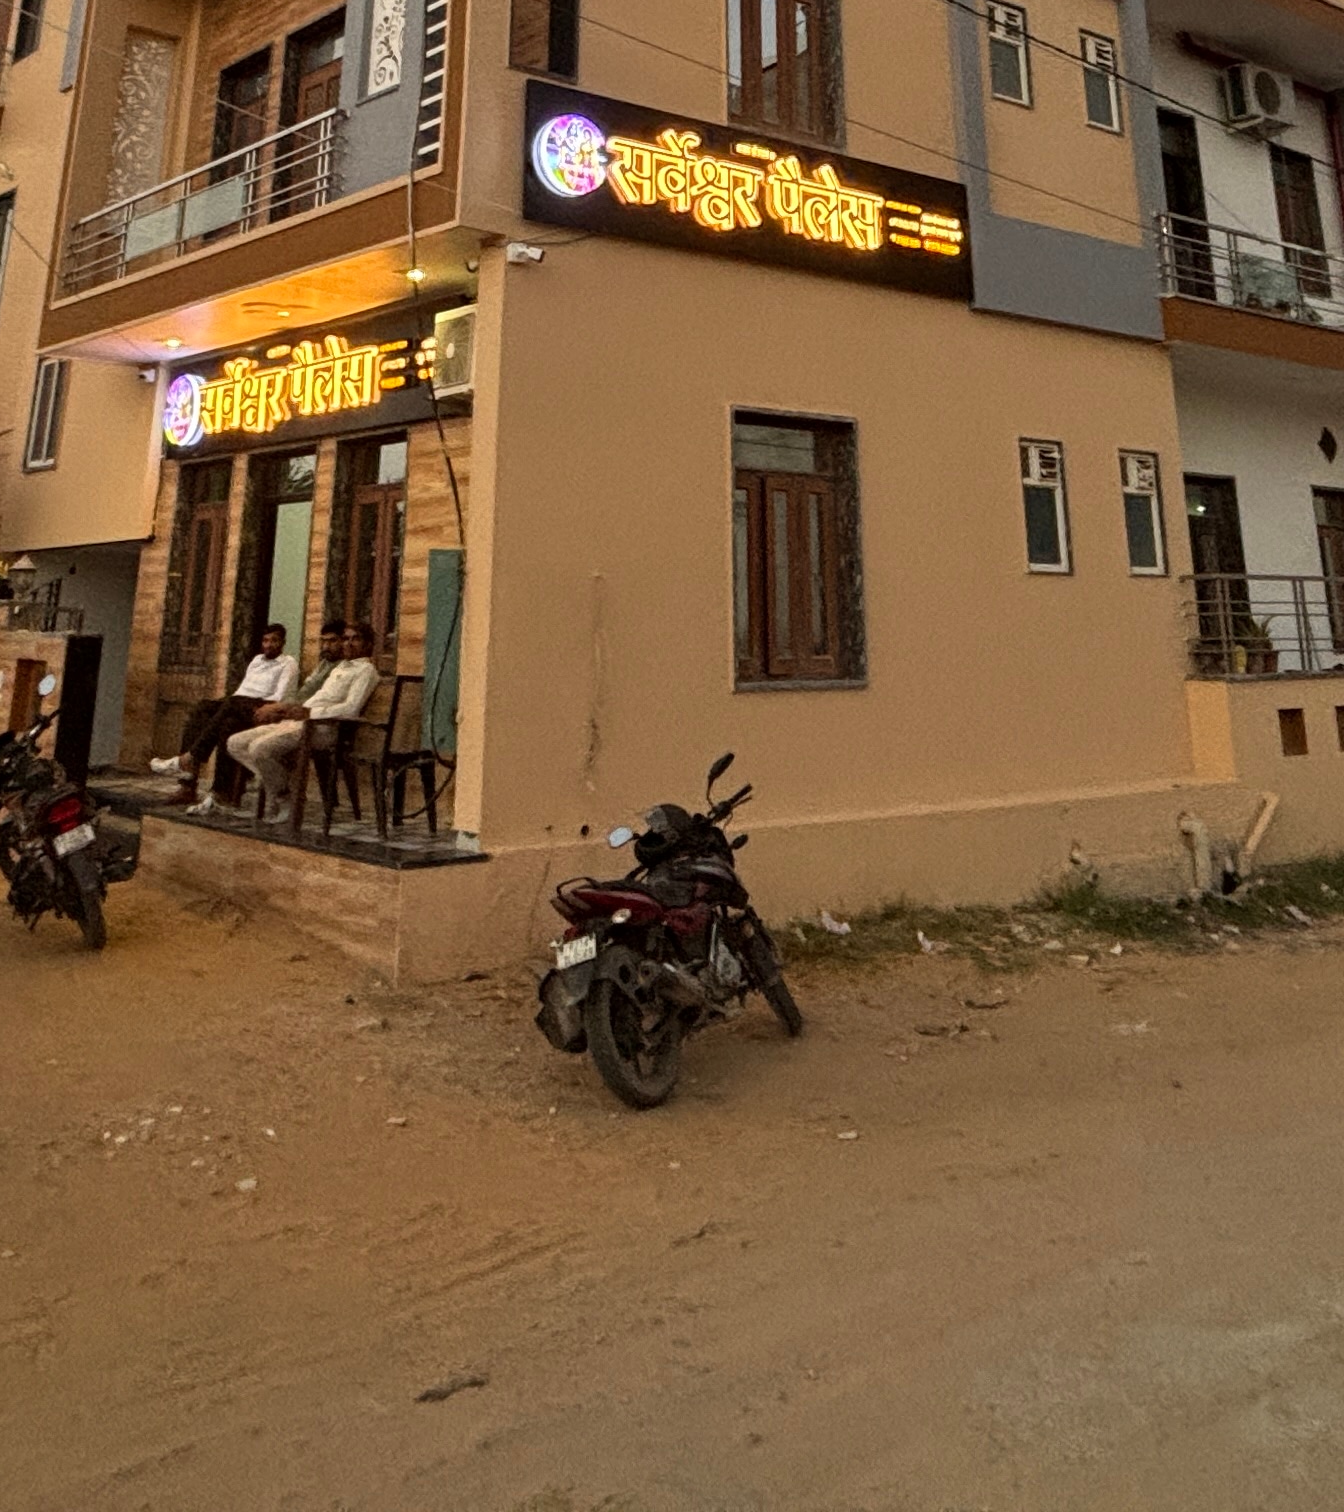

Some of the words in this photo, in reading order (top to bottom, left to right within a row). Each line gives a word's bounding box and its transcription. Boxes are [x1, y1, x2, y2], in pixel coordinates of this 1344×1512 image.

[607, 128, 764, 231] सर्वेश्वर
[766, 155, 885, 251] पैलेस
[287, 335, 382, 416] पैलेस
